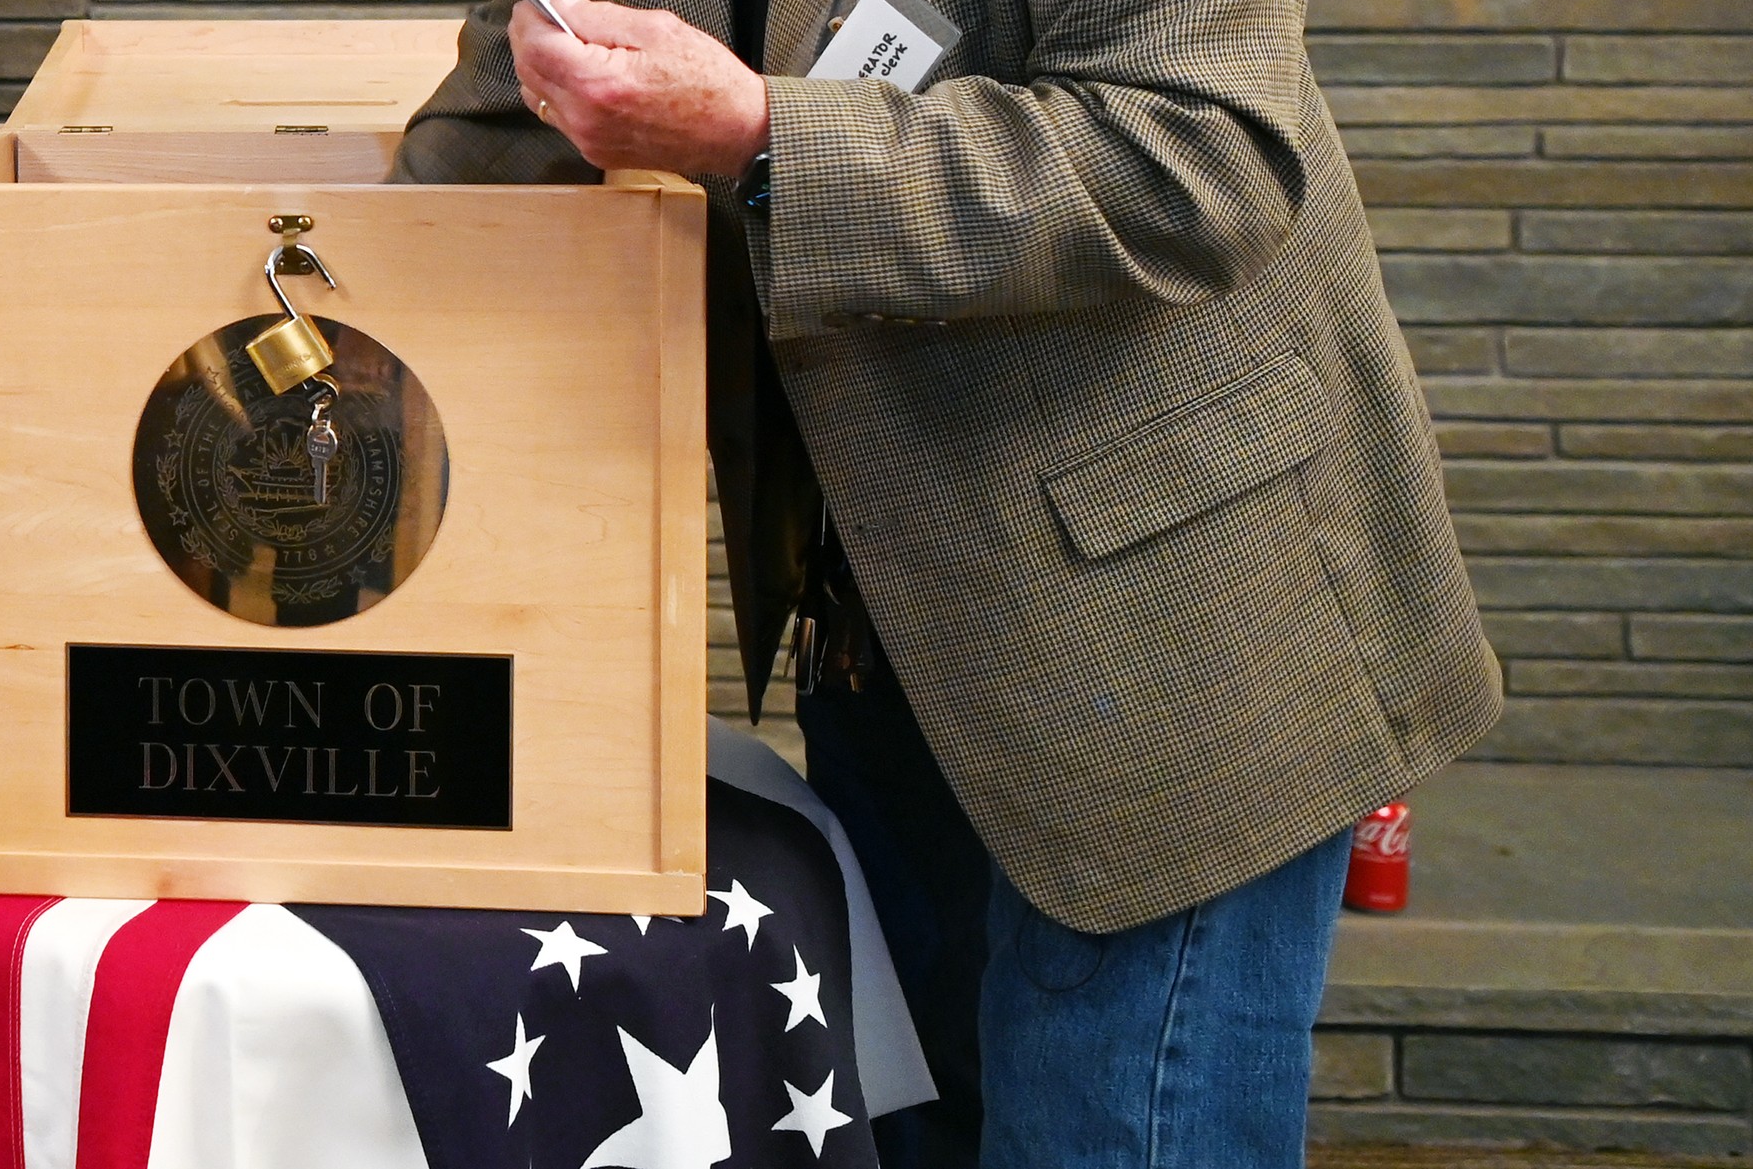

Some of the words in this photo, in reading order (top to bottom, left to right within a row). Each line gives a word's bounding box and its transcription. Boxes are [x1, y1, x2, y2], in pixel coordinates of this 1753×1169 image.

[859, 32, 897, 78] ERATOR
[138, 676, 326, 729] TOWN
[363, 682, 441, 733] OF
[138, 741, 441, 799] DIXVILLE
